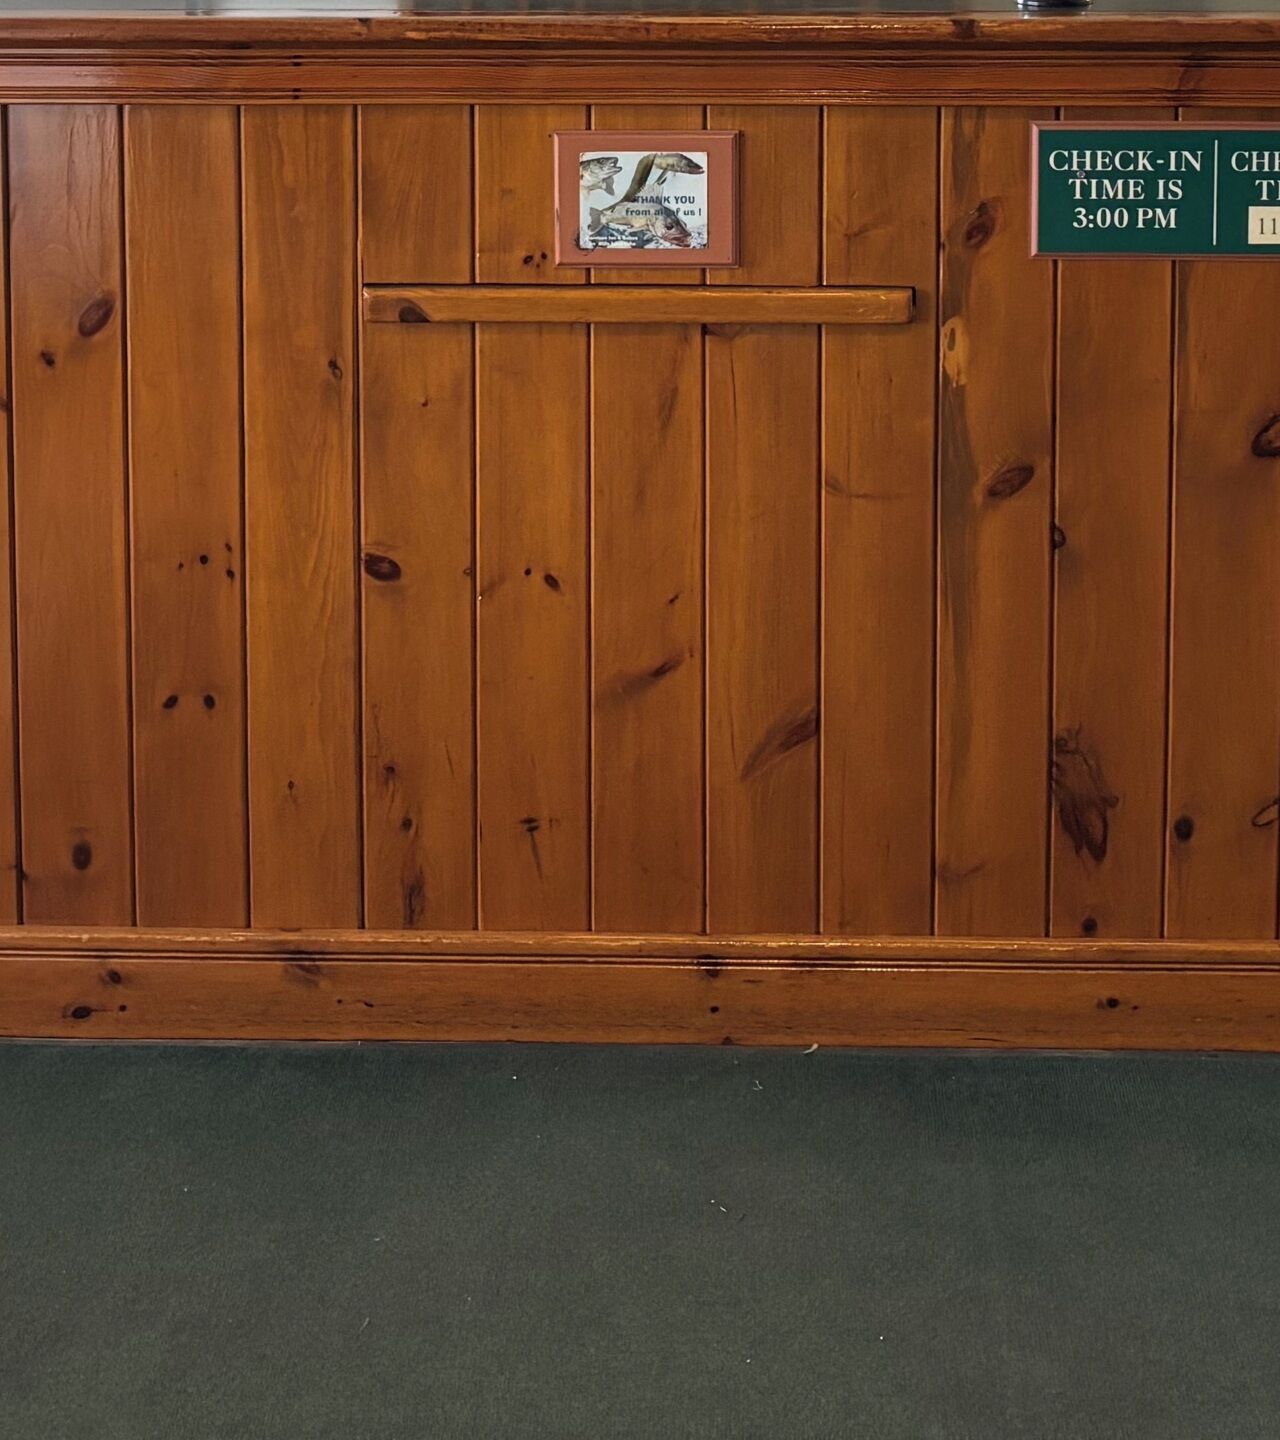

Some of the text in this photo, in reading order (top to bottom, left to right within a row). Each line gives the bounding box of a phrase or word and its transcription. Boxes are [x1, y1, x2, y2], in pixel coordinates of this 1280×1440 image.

[1048, 150, 1202, 172] CHECK-IN
[635, 195, 696, 205] THANK YOU
[1068, 178, 1183, 200] TIME IS
[625, 208, 651, 216] from
[1072, 207, 1177, 229] 3:00 PM
